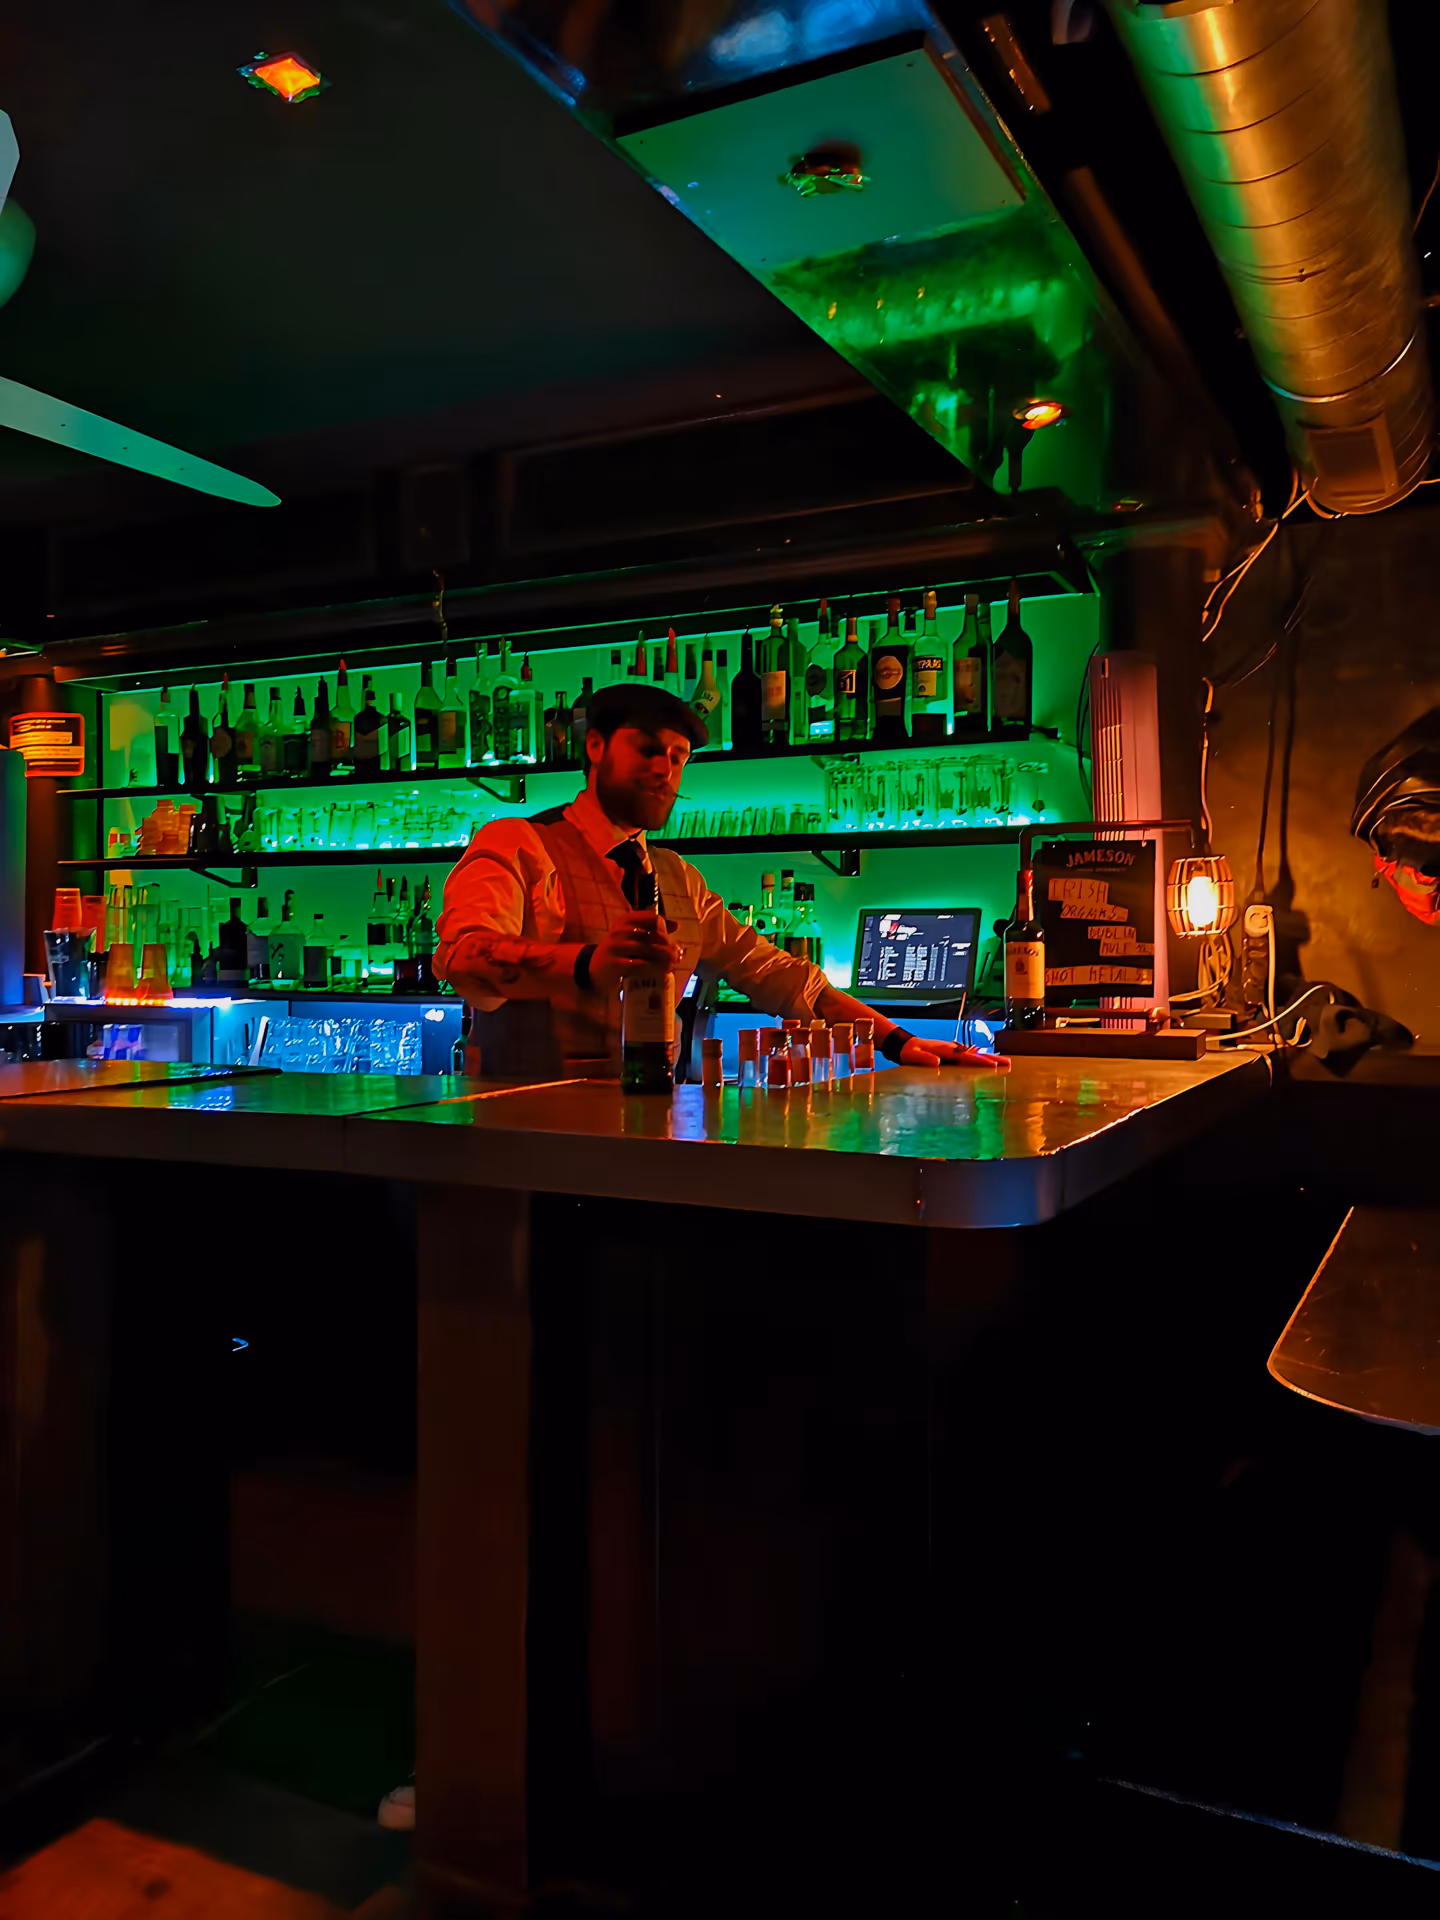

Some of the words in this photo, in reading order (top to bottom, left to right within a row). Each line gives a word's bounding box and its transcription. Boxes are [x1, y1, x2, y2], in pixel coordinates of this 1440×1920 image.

[1066, 848, 1136, 867] JAMESON
[1051, 879, 1107, 903] IRISH
[1089, 927, 1136, 939] DUBLIN
